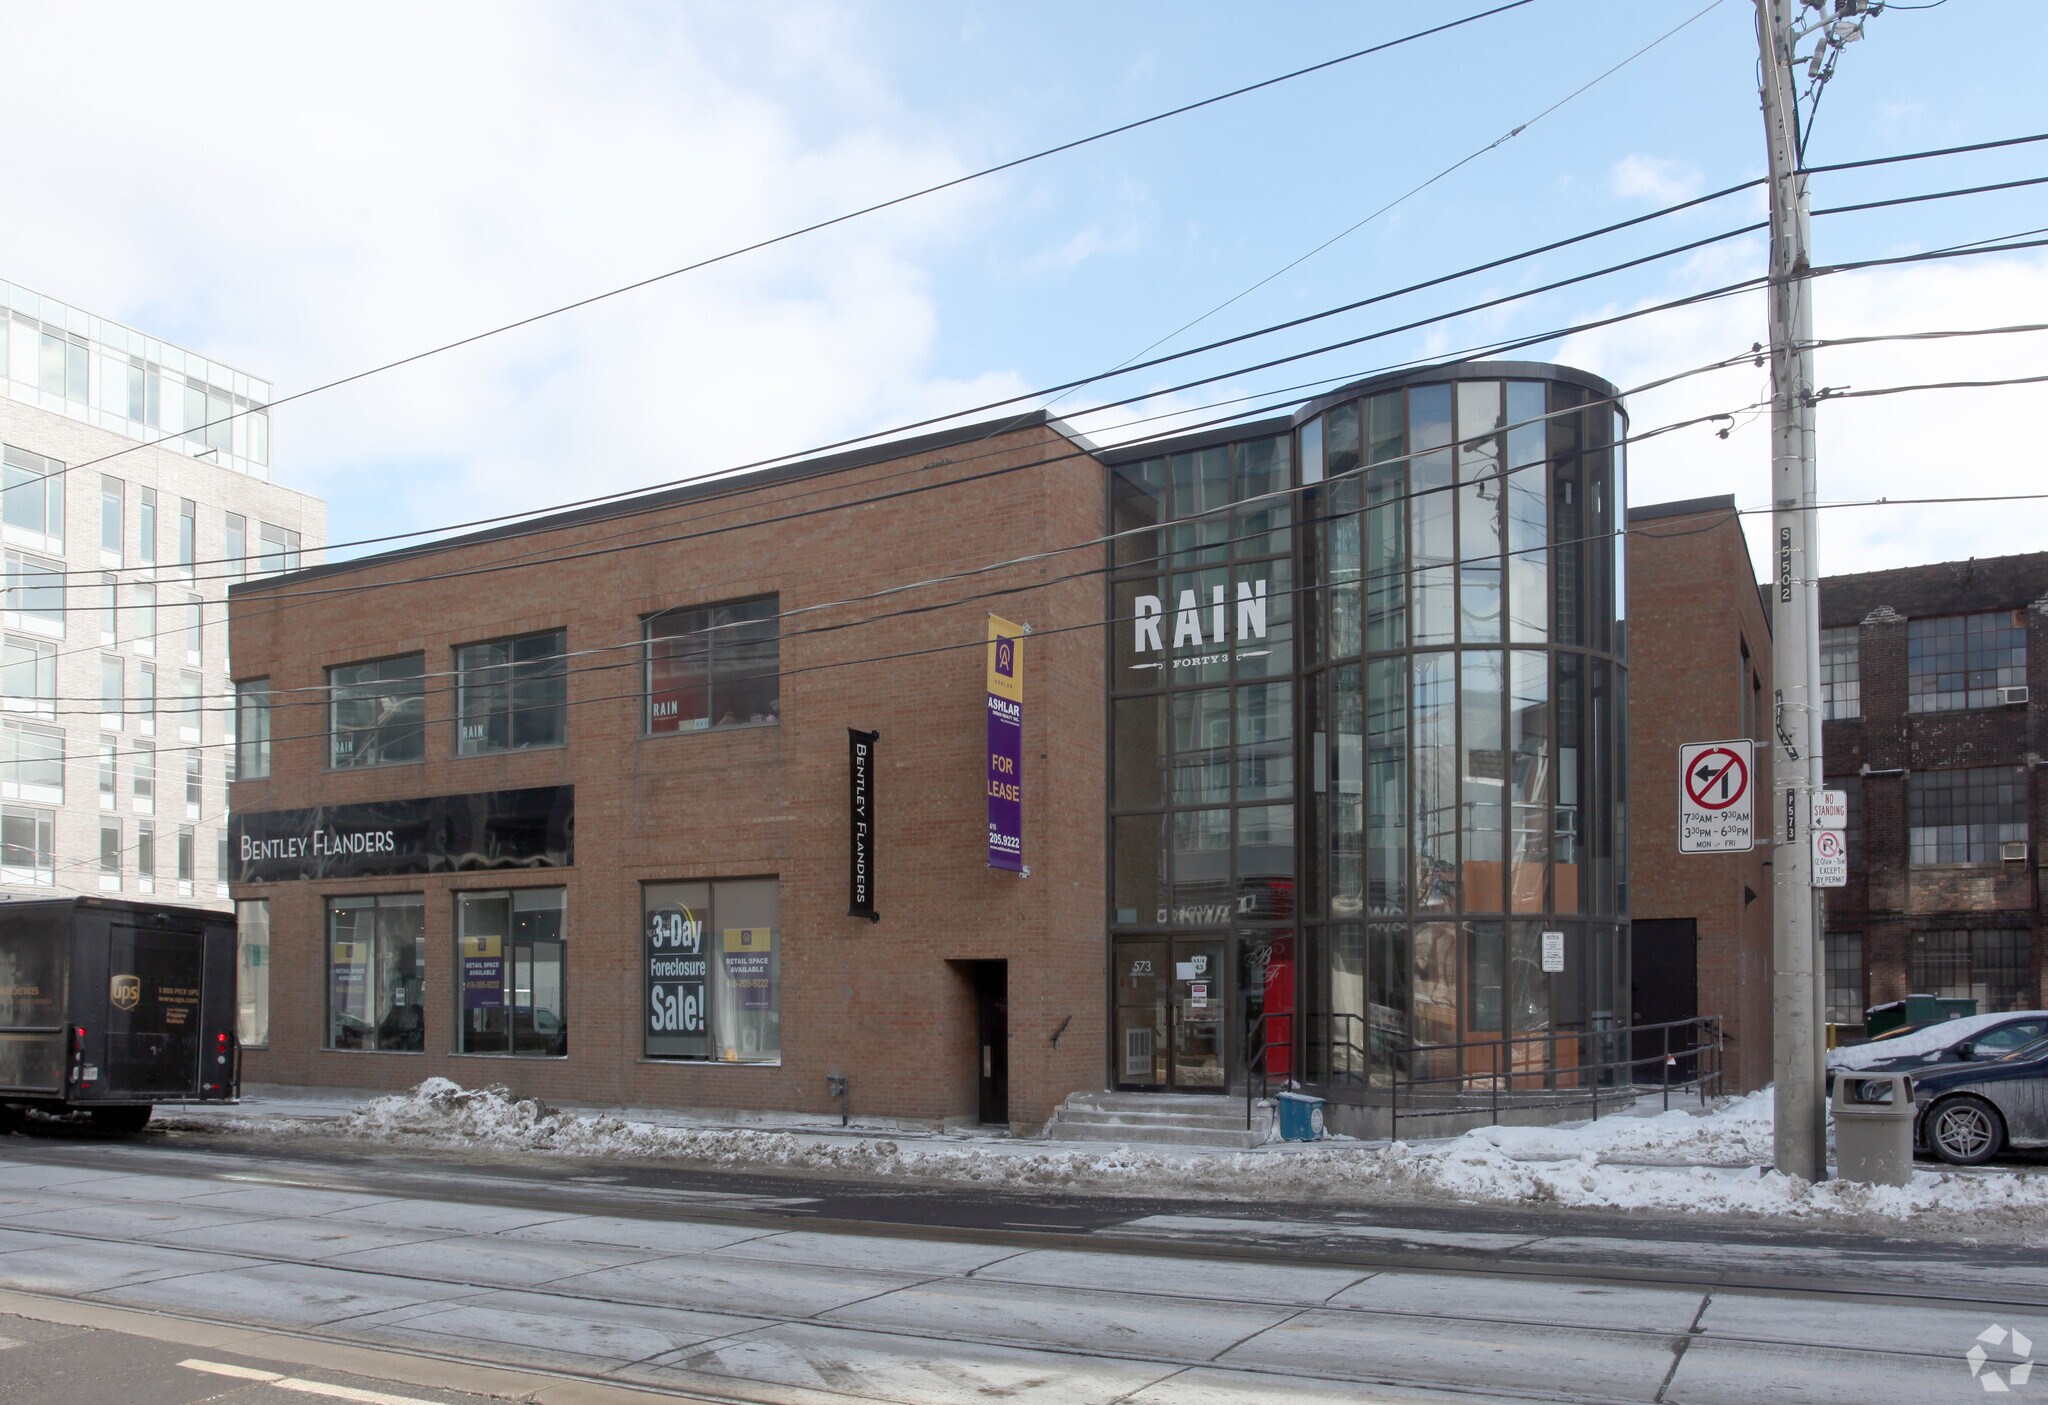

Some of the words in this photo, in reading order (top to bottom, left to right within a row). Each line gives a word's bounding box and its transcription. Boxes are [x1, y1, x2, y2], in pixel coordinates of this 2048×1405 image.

[1782, 529, 1790, 600] S5502
[1135, 579, 1267, 653] RAIN
[1173, 655, 1219, 669] FORTY
[1222, 654, 1229, 663] 3
[653, 700, 678, 716] RAIN
[988, 697, 1020, 716] ASHLAR
[463, 725, 484, 739] RAIN
[336, 740, 354, 754] RAIN
[992, 754, 1014, 775] FOR
[856, 743, 867, 817] BENTLEY
[987, 779, 1020, 802] LEASE
[1825, 793, 1834, 804] NO
[1814, 806, 1845, 816] STANDING
[241, 835, 308, 861] BENTLEY
[313, 830, 395, 856] FLANDERS
[989, 832, 1020, 849] 205.9222
[856, 822, 868, 903] FLANDERS
[1824, 876, 1845, 884] PERMIT
[652, 913, 703, 954] 3-Day
[650, 958, 706, 977] Foreclosure
[1133, 960, 1151, 972] 573
[113, 986, 138, 1005] ups
[651, 985, 704, 1030] Sale!
